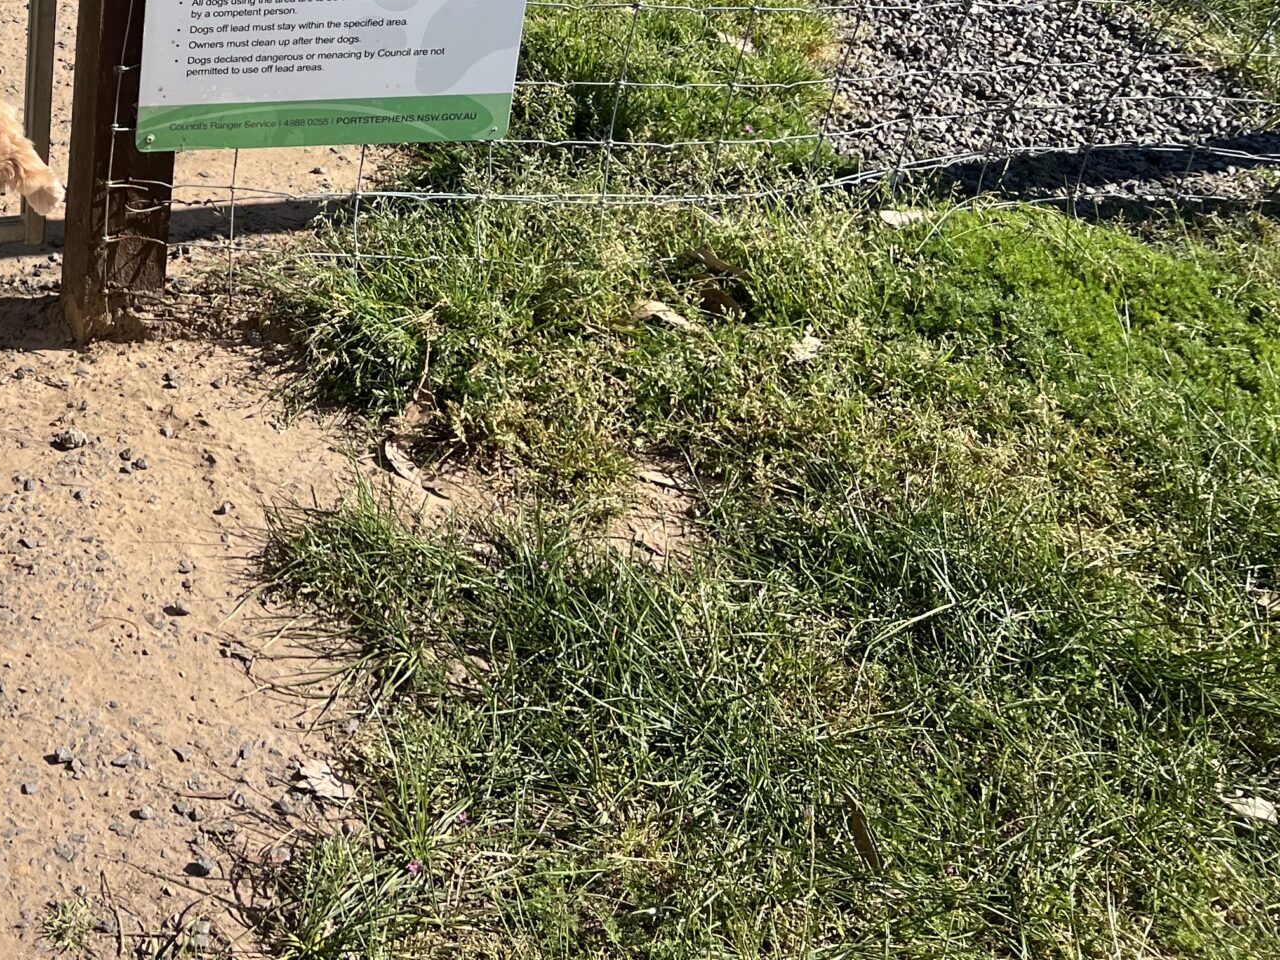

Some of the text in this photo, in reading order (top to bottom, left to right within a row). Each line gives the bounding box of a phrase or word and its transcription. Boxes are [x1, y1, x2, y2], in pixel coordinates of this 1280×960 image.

[191, 10, 202, 20] by
[212, 8, 262, 18] competent
[263, 7, 297, 17] person.
[189, 25, 214, 35] Dogs
[216, 24, 229, 33] off
[230, 23, 250, 33] lead
[252, 22, 275, 32] must
[277, 22, 296, 32] stay
[298, 20, 325, 30] within
[327, 20, 341, 29] the
[343, 18, 384, 29] specified
[188, 35, 362, 50] Owners must clean up after their dogs.
[187, 56, 212, 66] Dogs
[213, 54, 253, 64] declared
[255, 53, 304, 63] dangerous
[317, 50, 362, 60] menacing
[363, 49, 375, 60] by
[377, 48, 411, 58] Council
[430, 47, 445, 56] not
[186, 64, 324, 78] permitted to use off lead areas.
[210, 121, 242, 131] Ranger
[244, 119, 277, 129] Service
[283, 118, 306, 127] 4988
[307, 117, 329, 126] 0255
[335, 112, 477, 125] PORTSTEPHENS.NSW.GOV.AU
